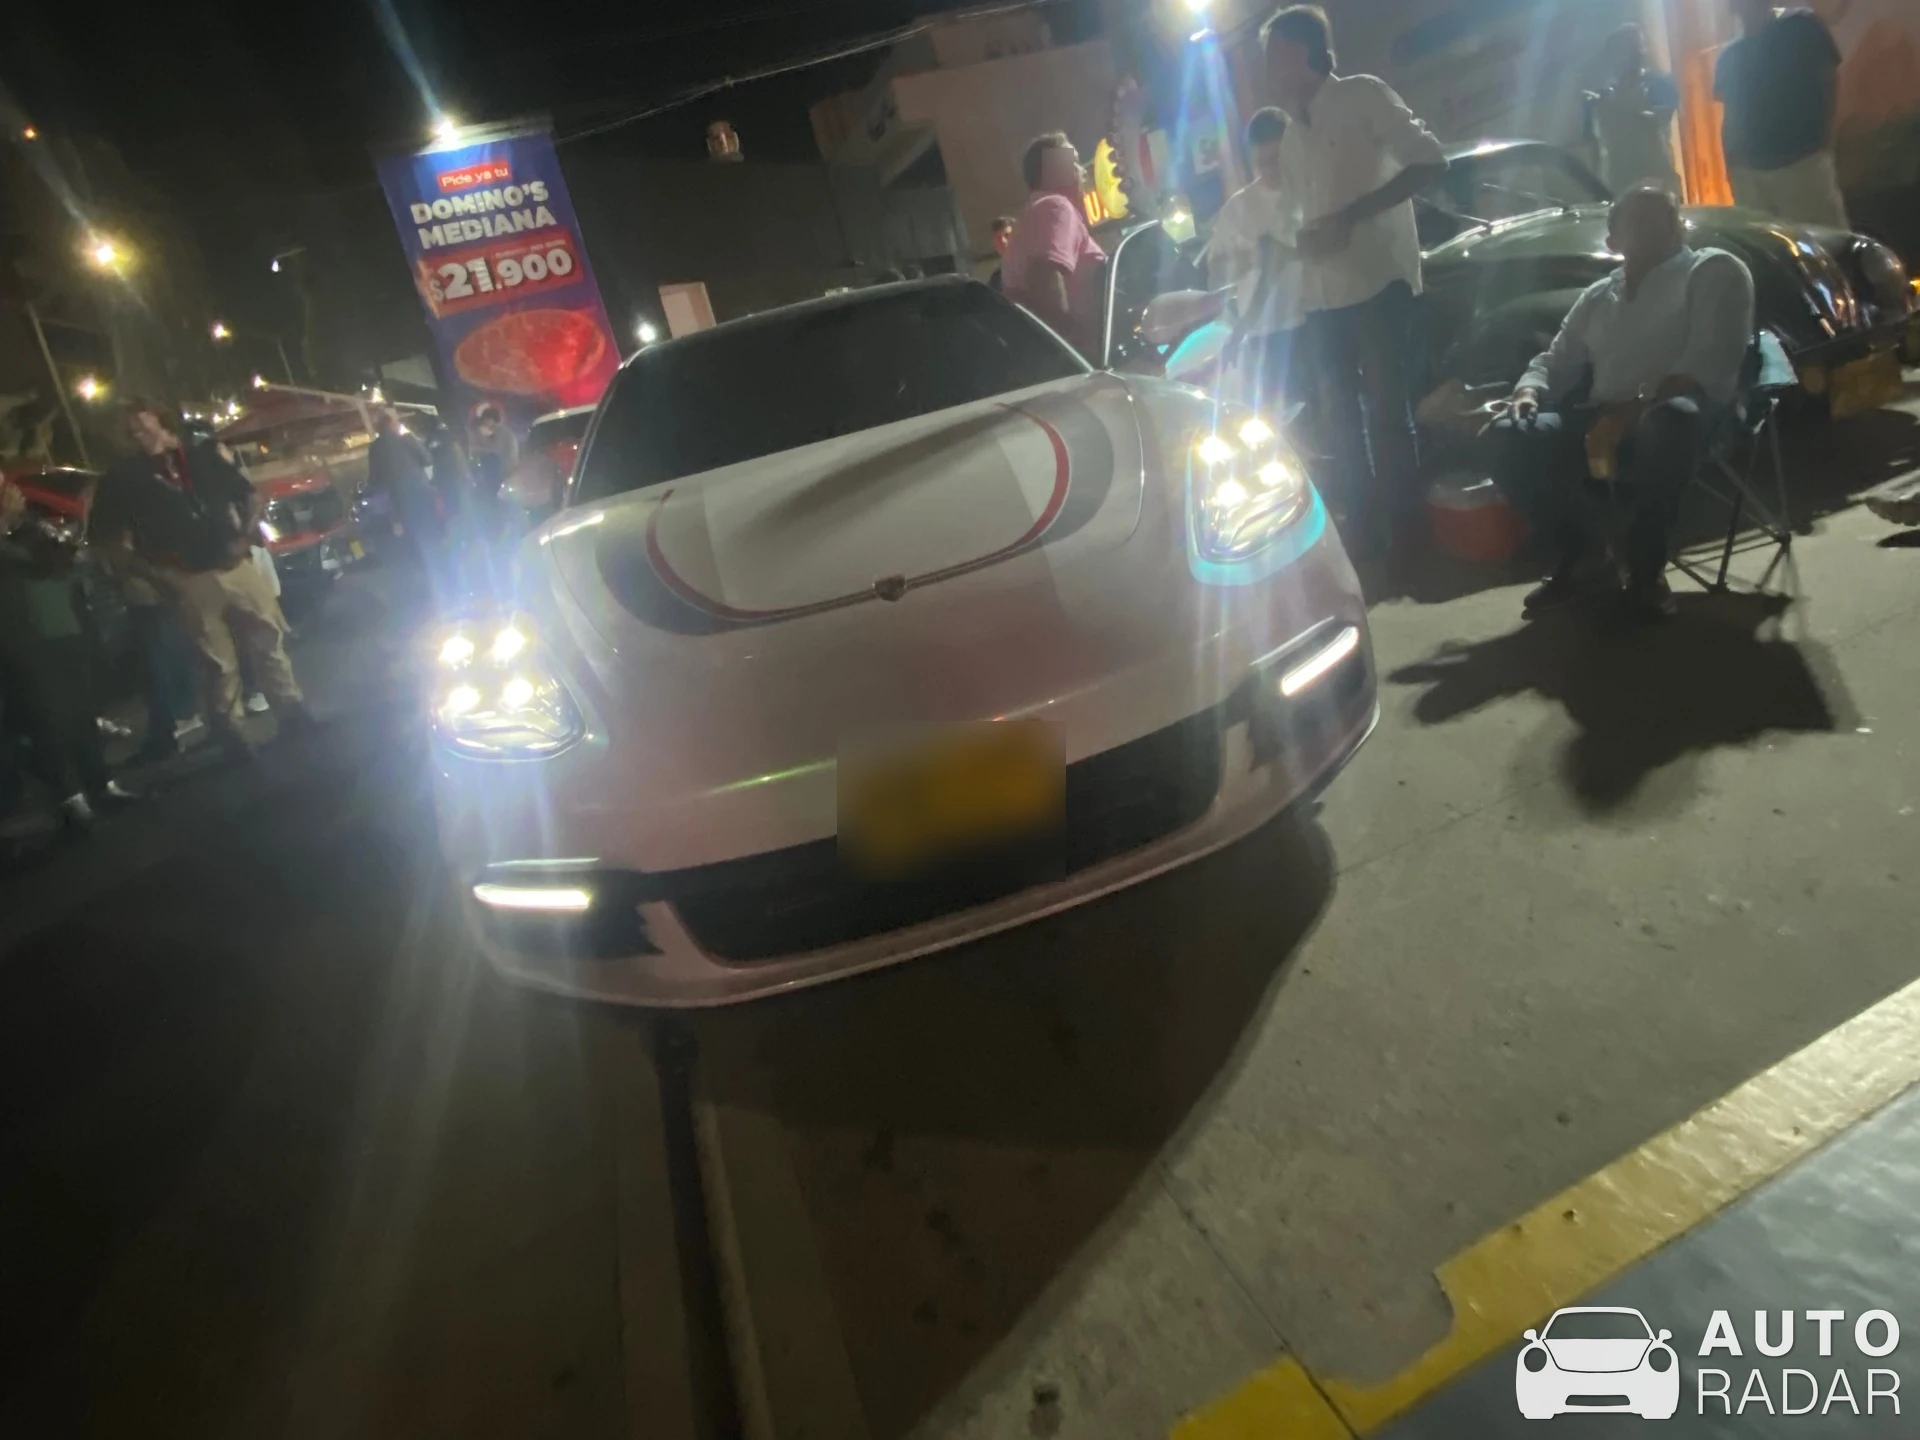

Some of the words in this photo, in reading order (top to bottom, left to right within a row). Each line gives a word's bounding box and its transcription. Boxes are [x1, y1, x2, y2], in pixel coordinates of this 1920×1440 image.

[441, 174, 473, 187] Pide
[474, 170, 492, 183] ya
[494, 167, 509, 178] tu
[410, 181, 549, 224] DOMINO'S
[418, 206, 557, 249] MEDIANA
[429, 248, 572, 302] $21.900
